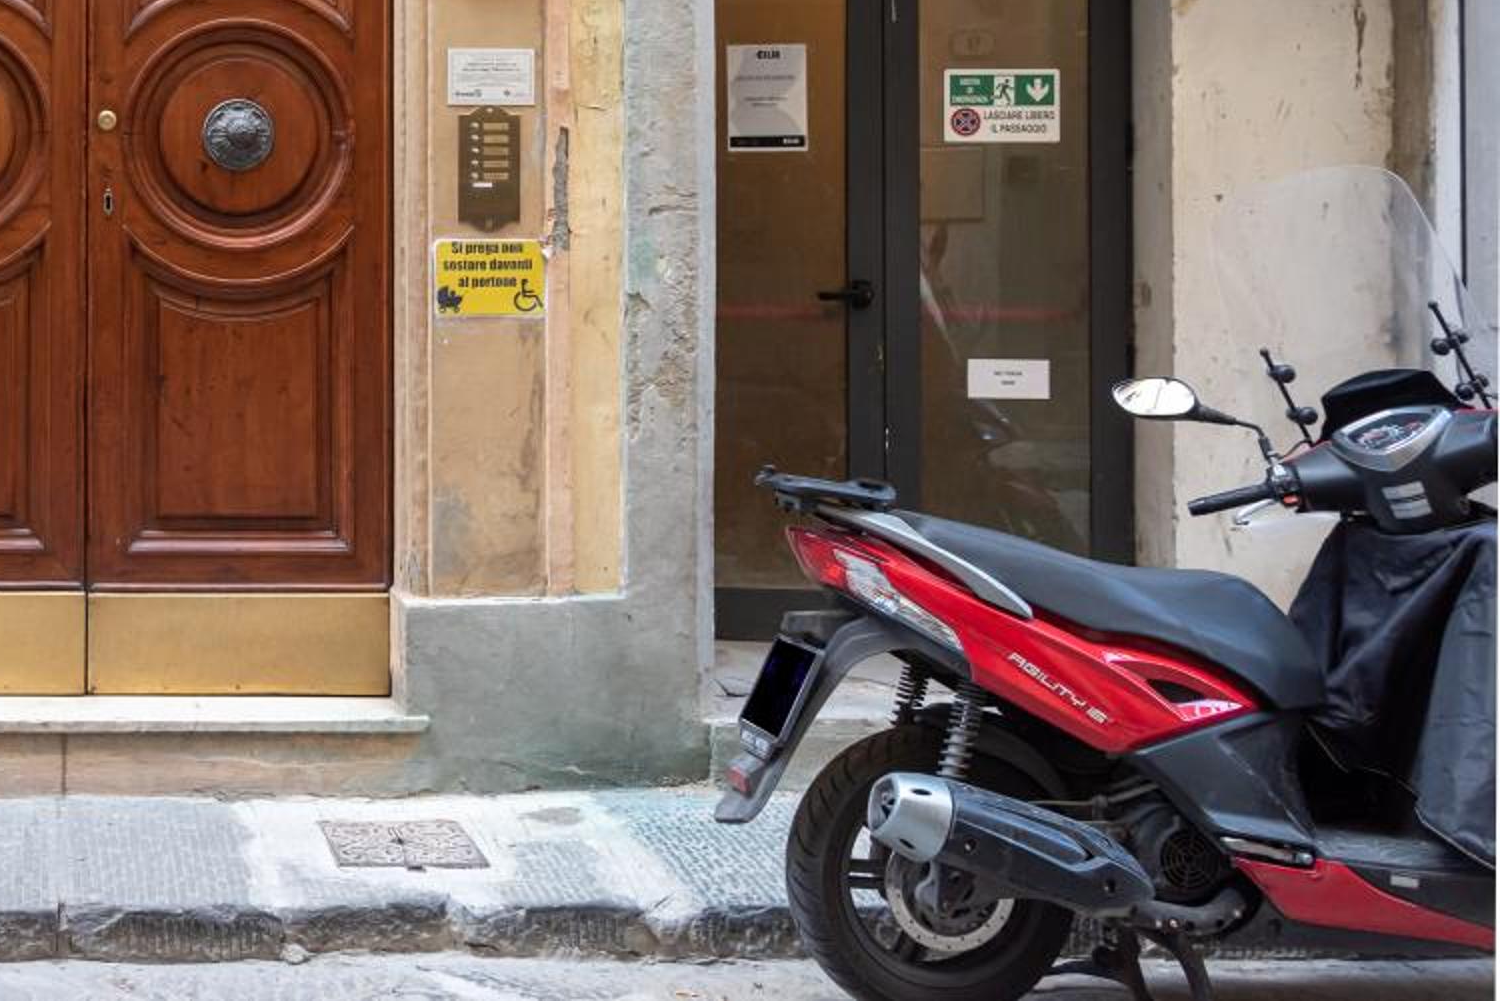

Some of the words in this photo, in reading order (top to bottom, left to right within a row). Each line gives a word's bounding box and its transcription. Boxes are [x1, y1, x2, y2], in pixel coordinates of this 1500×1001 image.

[983, 110, 1022, 120] LASCIARE
[1025, 110, 1055, 120] LIBERO
[991, 124, 998, 133] IL
[1000, 123, 1046, 134] PASSAGGIO
[452, 241, 462, 253] Si
[465, 242, 499, 255] prega
[501, 242, 523, 253] non
[443, 259, 487, 270] sostare
[489, 258, 532, 270] davanti
[458, 277, 469, 287] al
[471, 276, 517, 288] portone
[1007, 652, 1087, 707] AGILITY
